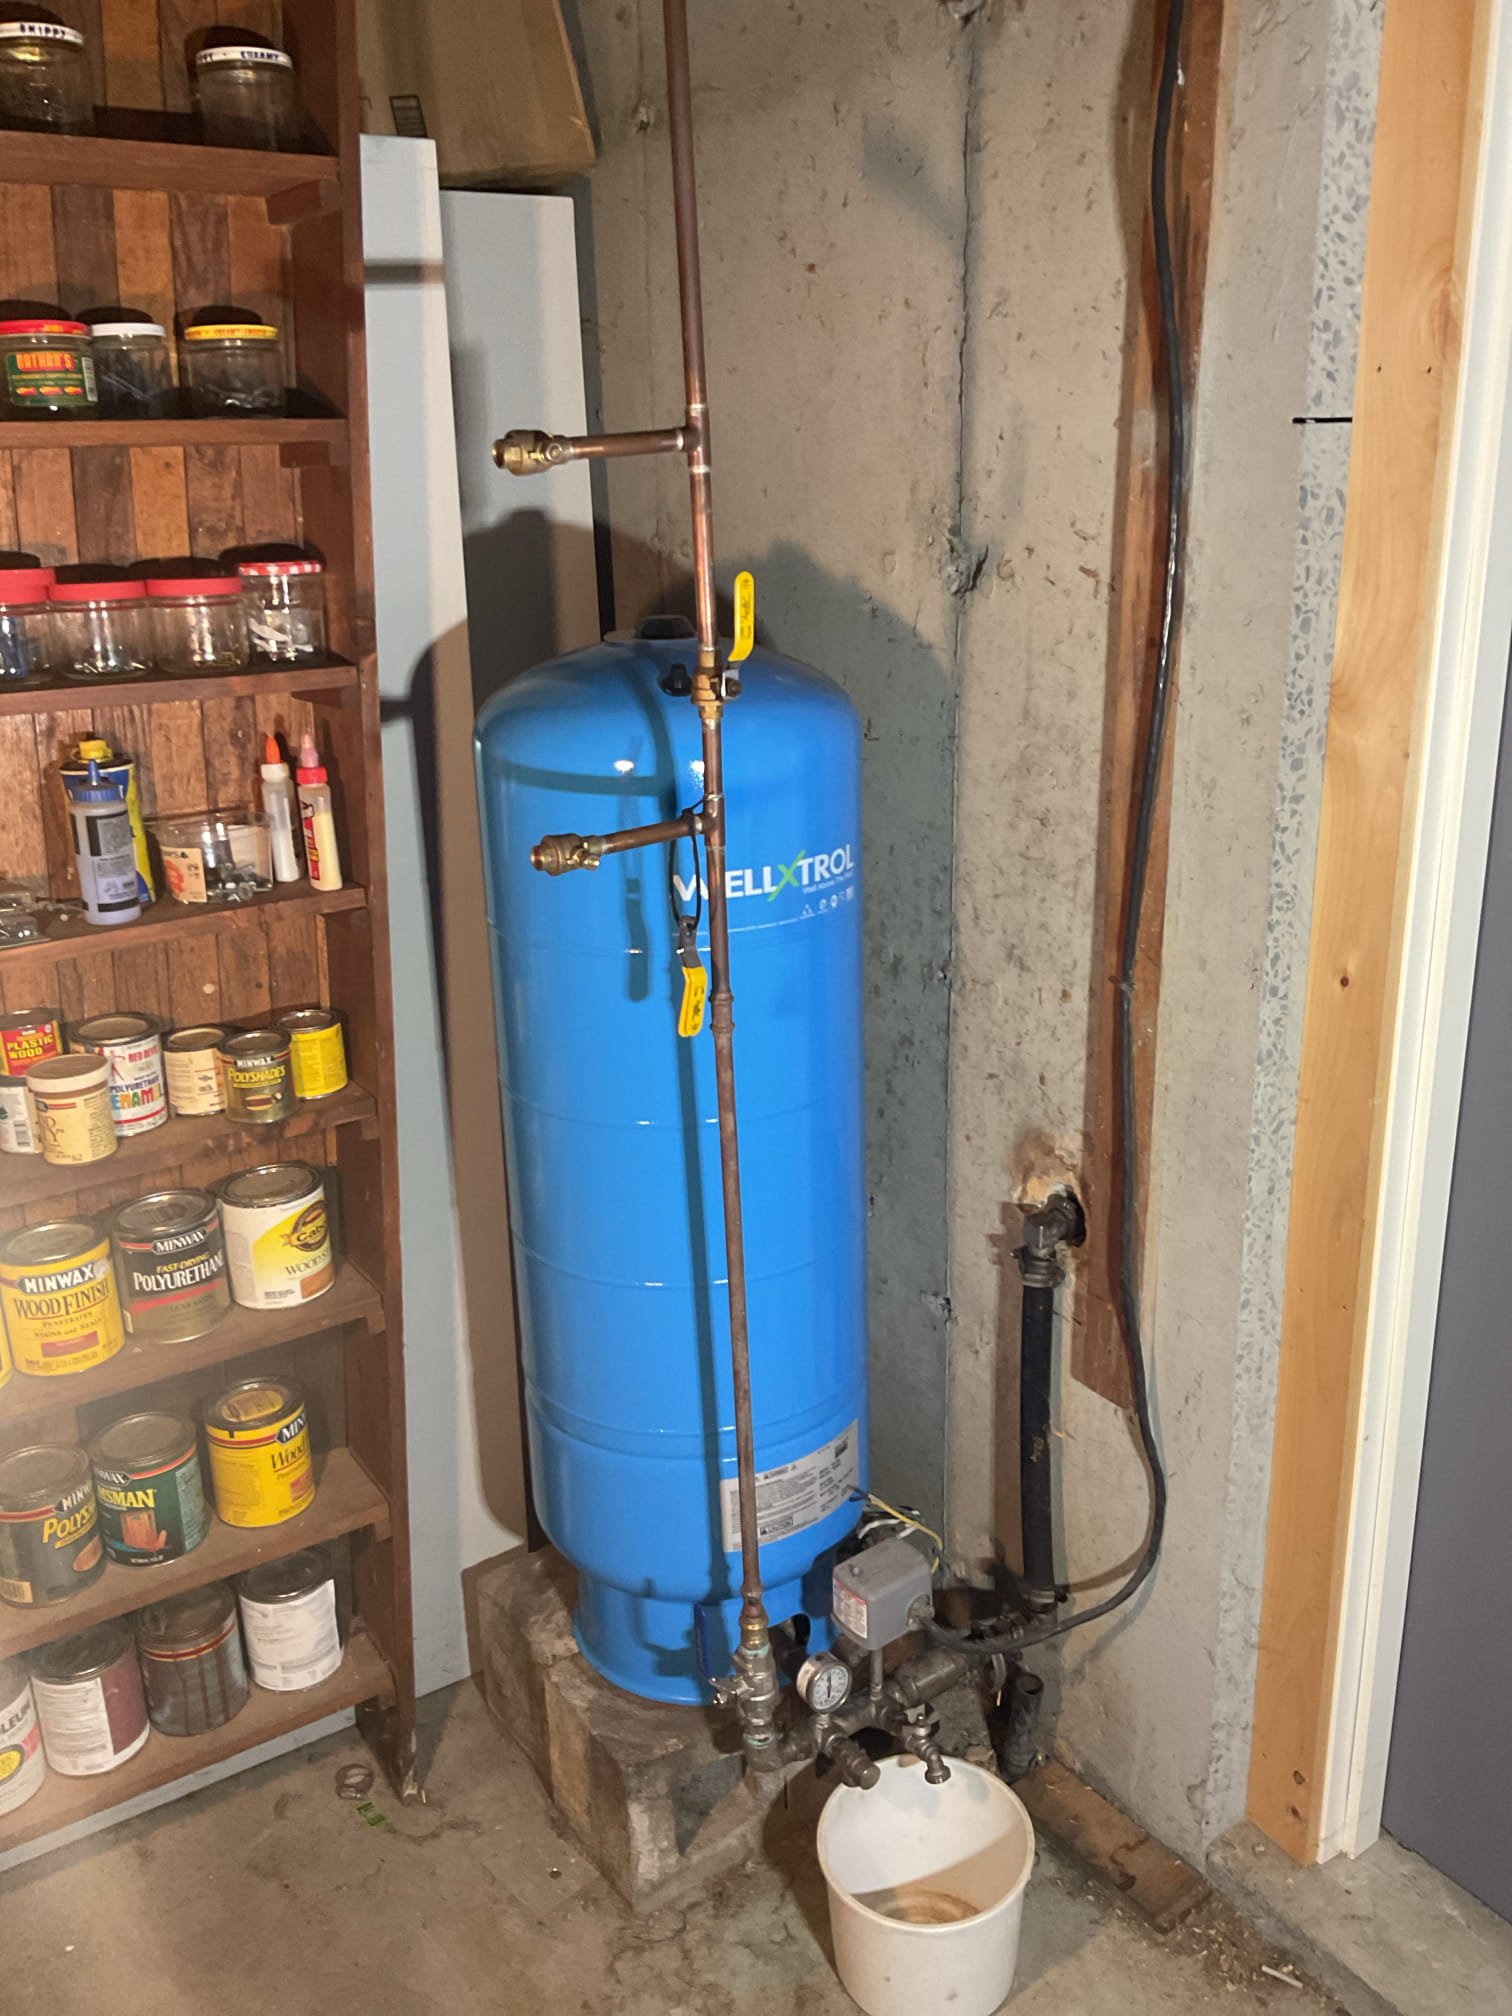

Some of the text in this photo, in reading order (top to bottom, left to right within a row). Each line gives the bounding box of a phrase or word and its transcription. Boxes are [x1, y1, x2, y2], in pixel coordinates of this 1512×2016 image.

[20, 23, 66, 38] SKIPPY
[7, 1034, 54, 1051] PLASTIC
[8, 1047, 43, 1059] WOOD
[236, 1057, 273, 1068] MINWAX
[227, 1065, 286, 1083] POLYSHADES
[157, 1231, 206, 1252] MINWAX
[24, 1263, 94, 1293] MINWAX
